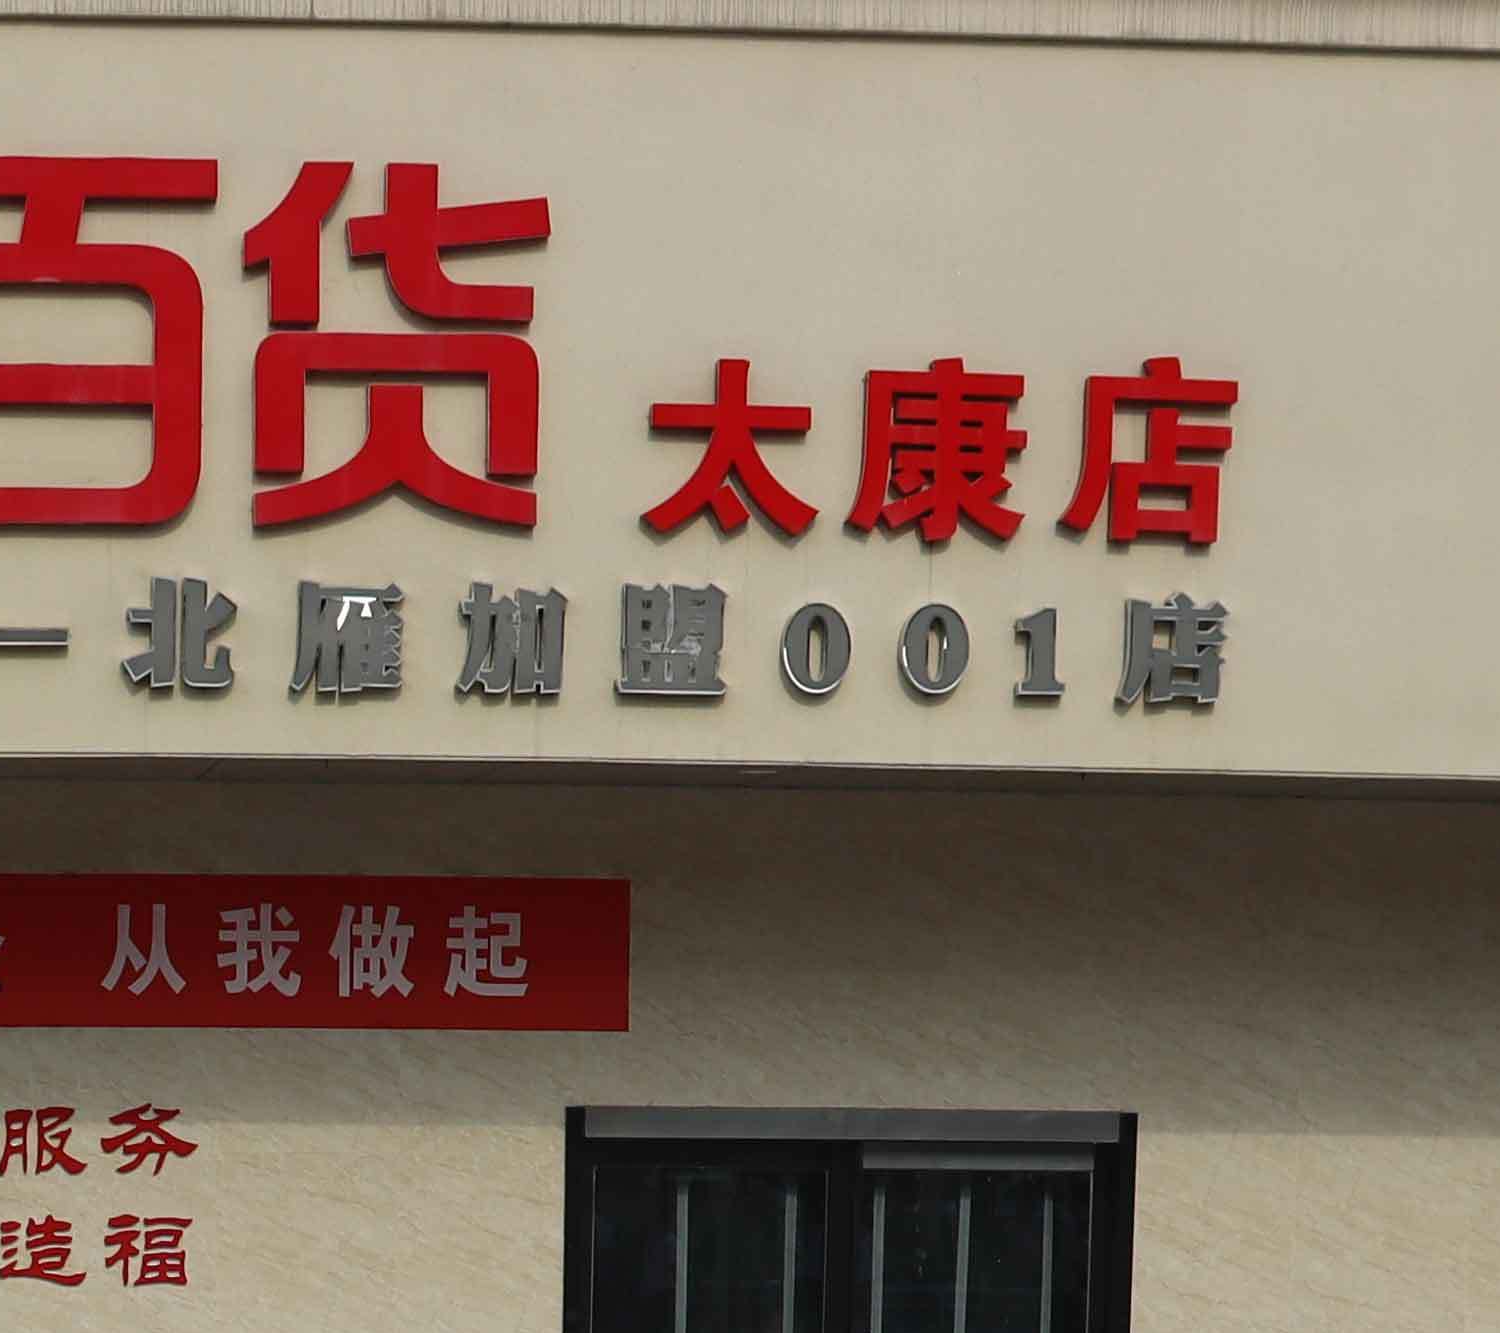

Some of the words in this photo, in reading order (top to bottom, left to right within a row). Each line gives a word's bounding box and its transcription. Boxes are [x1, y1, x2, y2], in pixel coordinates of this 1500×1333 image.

[640, 356, 1239, 543] 太康店
[100, 903, 532, 999] 从我做起
